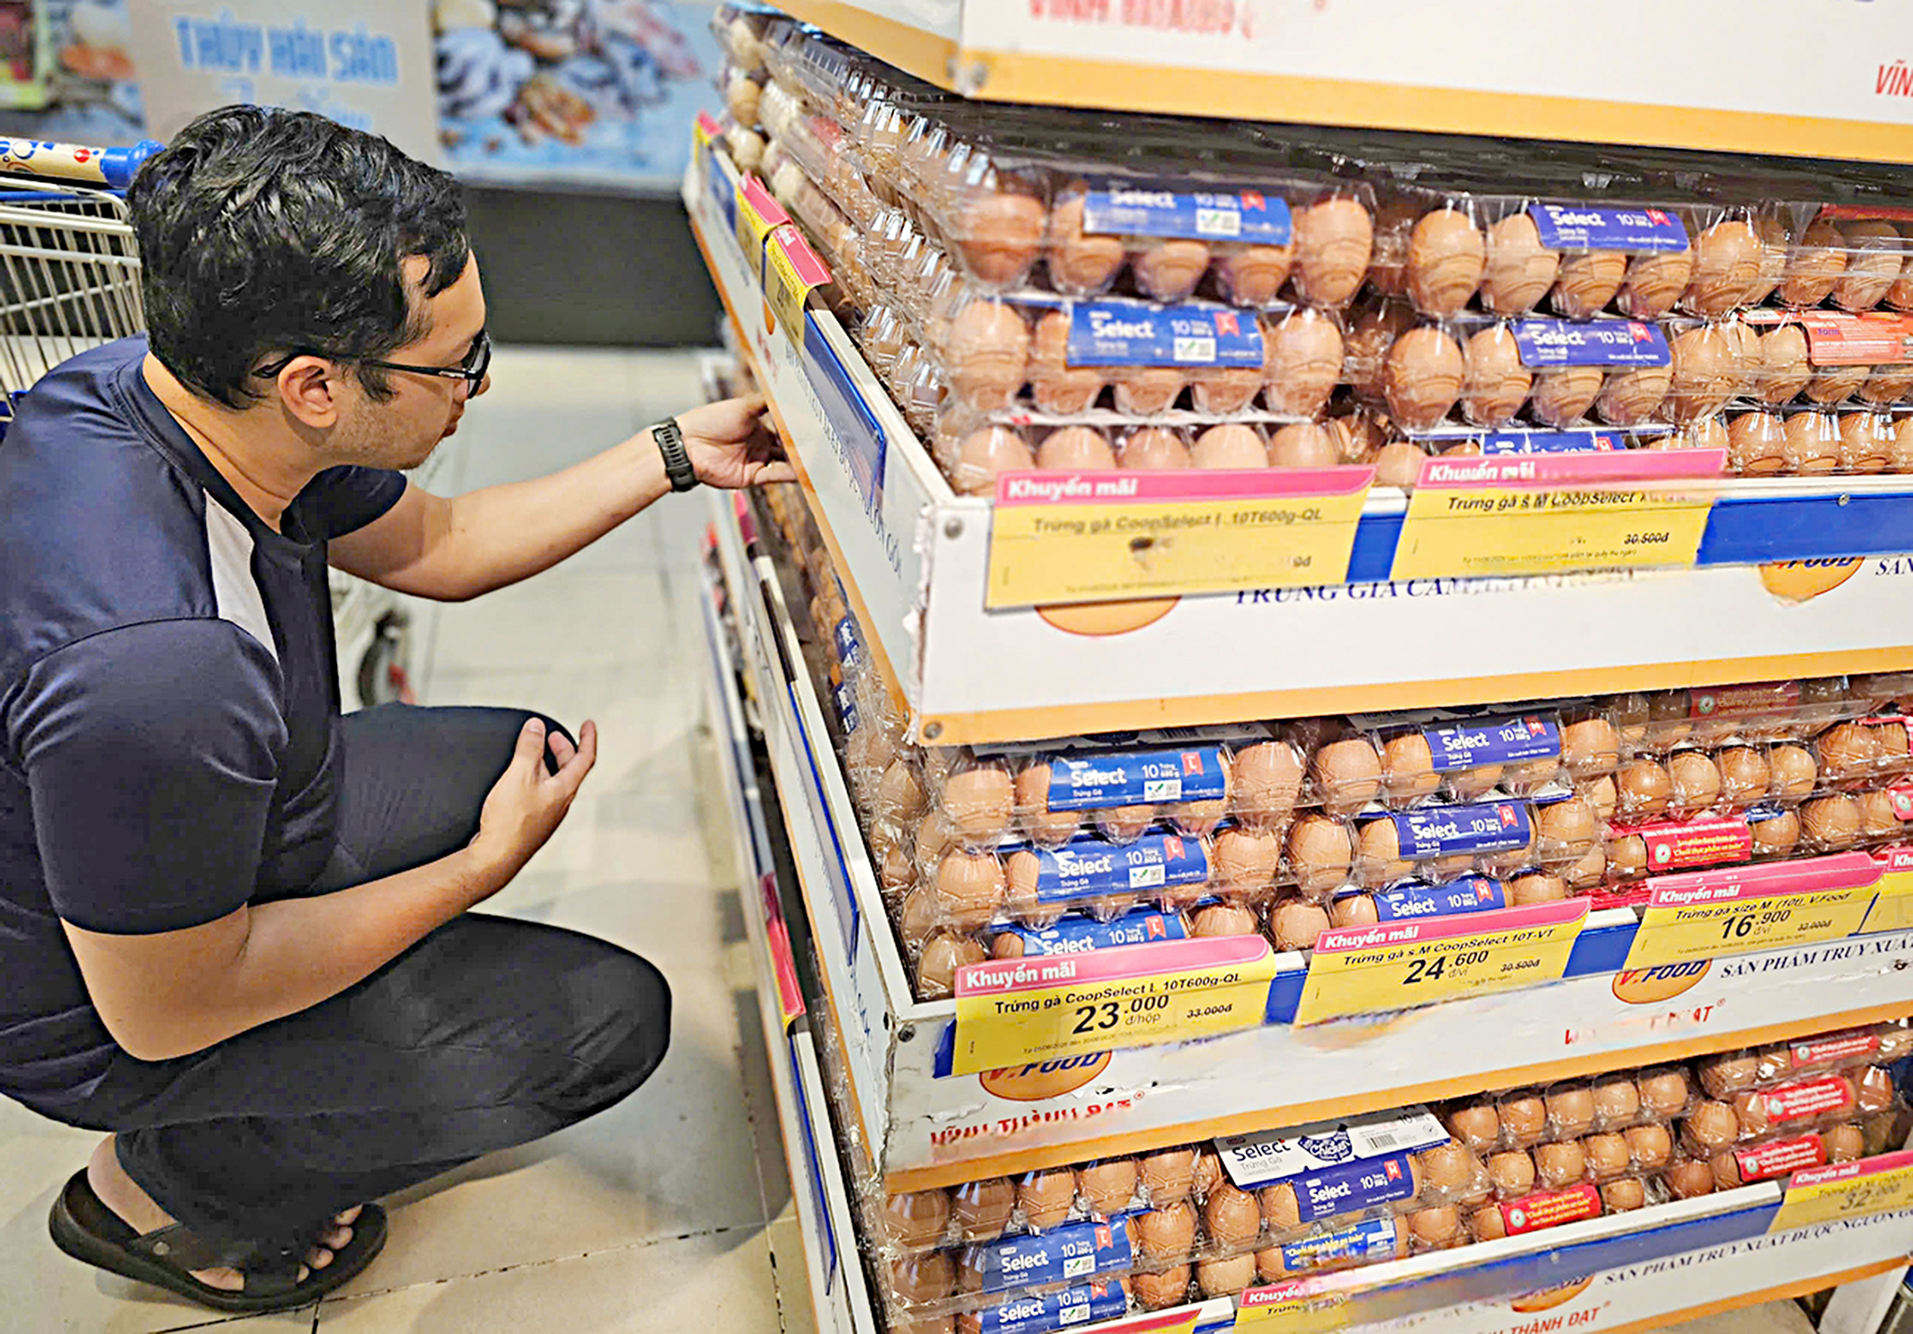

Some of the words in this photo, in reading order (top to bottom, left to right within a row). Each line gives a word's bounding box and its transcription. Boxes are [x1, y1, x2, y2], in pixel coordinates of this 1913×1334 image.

[1876, 59, 1913, 98] VĨN
[1549, 211, 1606, 226] Select
[1616, 214, 1633, 225] 10
[1092, 320, 1155, 338] Select
[1171, 320, 1190, 335] 10
[1531, 331, 1586, 345] Select
[1597, 332, 1614, 344] 10
[1008, 474, 1089, 502] Khuyến
[1096, 477, 1137, 496] mãi
[1442, 732, 1490, 752] Select
[1499, 729, 1514, 742] 10
[1071, 767, 1127, 787] Select
[1141, 764, 1159, 779] 10
[1411, 822, 1459, 840] Select
[1470, 819, 1485, 832] 10
[1058, 857, 1112, 878] Select
[1126, 850, 1143, 865] 10
[1391, 899, 1437, 918] Select
[1447, 894, 1462, 908] 10
[1659, 884, 1711, 904] Khuyến
[1713, 885, 1740, 898] mãi
[1759, 901, 1772, 910] M
[1042, 935, 1095, 956] Select
[1109, 930, 1125, 944] 10
[1325, 928, 1386, 950] Khuyến
[1388, 925, 1419, 940] mãi
[1433, 936, 1508, 954] CoopSelect
[966, 968, 1038, 990] Khuyến
[1042, 961, 1076, 979] mãi
[995, 999, 1039, 1016] Trứng
[1044, 994, 1062, 1010] gà
[1065, 985, 1147, 1005] CoopSelect
[1163, 973, 1243, 993] 10T600g-QL
[1231, 1139, 1291, 1163] Select
[1309, 1181, 1351, 1203] Select
[1360, 1176, 1374, 1189] 10
[1001, 1249, 1049, 1274] Select
[1062, 1243, 1076, 1258] 10
[999, 1302, 1045, 1323] Select
[1057, 1293, 1071, 1306] 10
